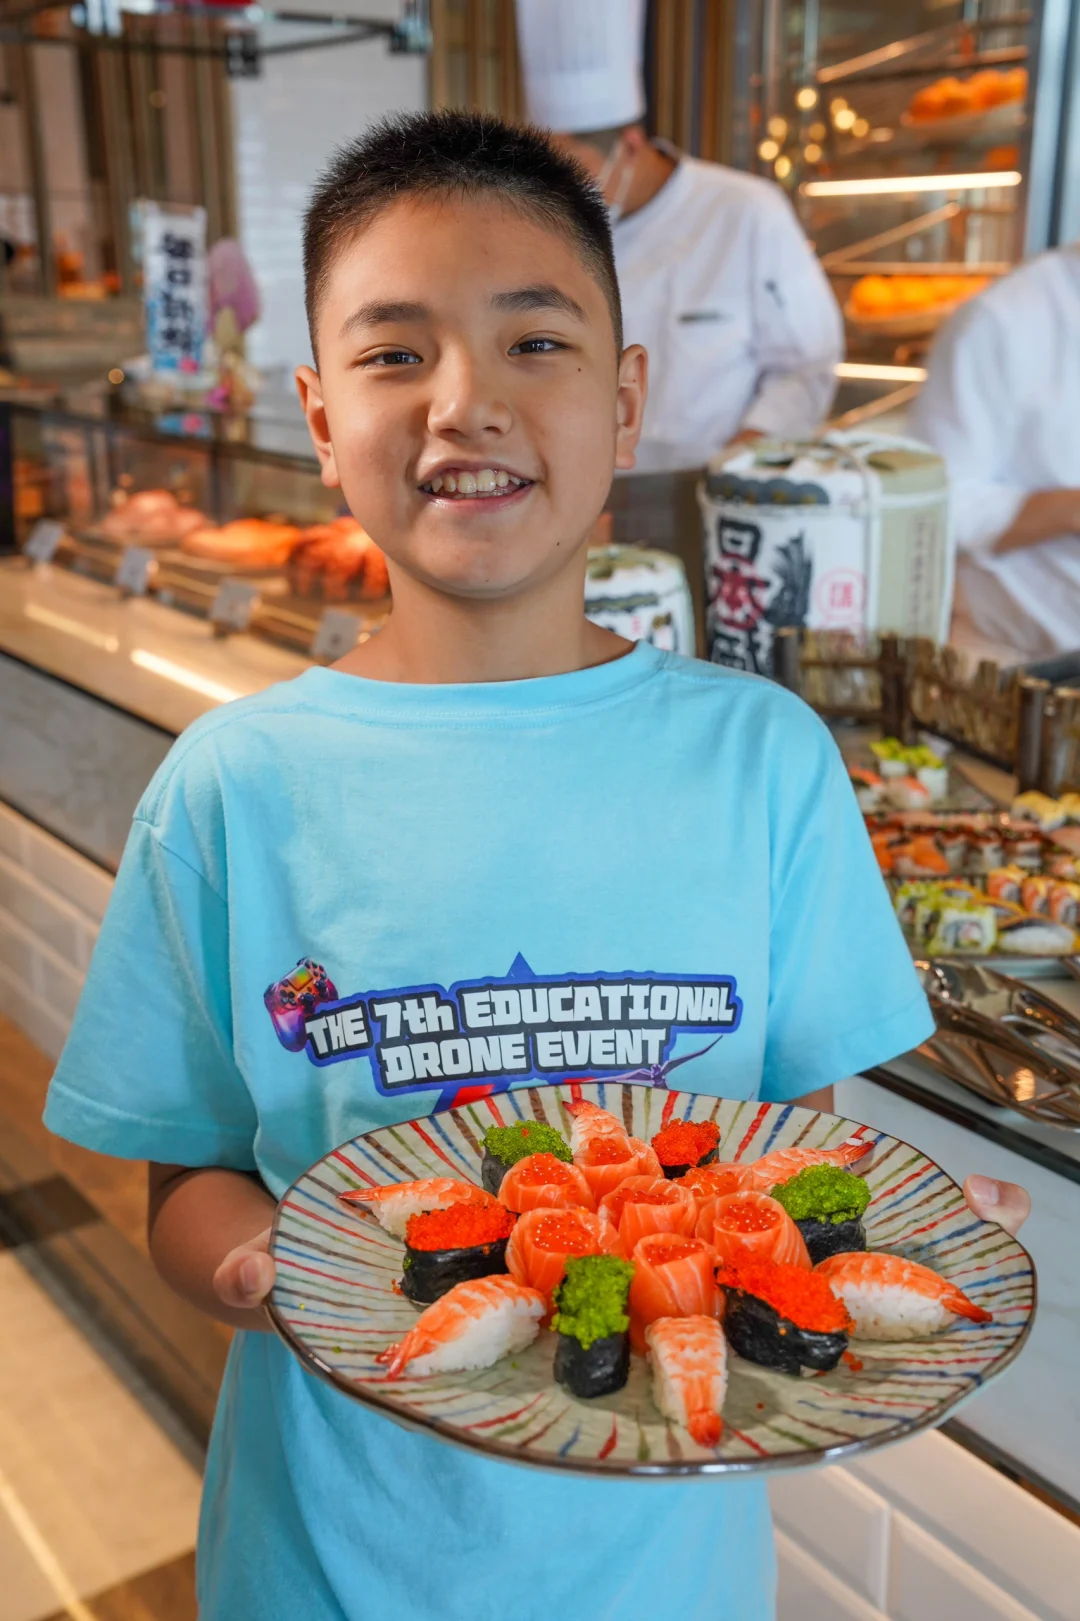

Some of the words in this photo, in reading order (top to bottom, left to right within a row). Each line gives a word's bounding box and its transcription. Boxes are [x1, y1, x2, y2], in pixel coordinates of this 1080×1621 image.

[305, 1006, 369, 1055] THE
[373, 996, 455, 1039] 7th
[462, 984, 734, 1028] EDUCATIONAL
[380, 1032, 527, 1084] DRONE
[535, 1028, 667, 1068] EVENT
